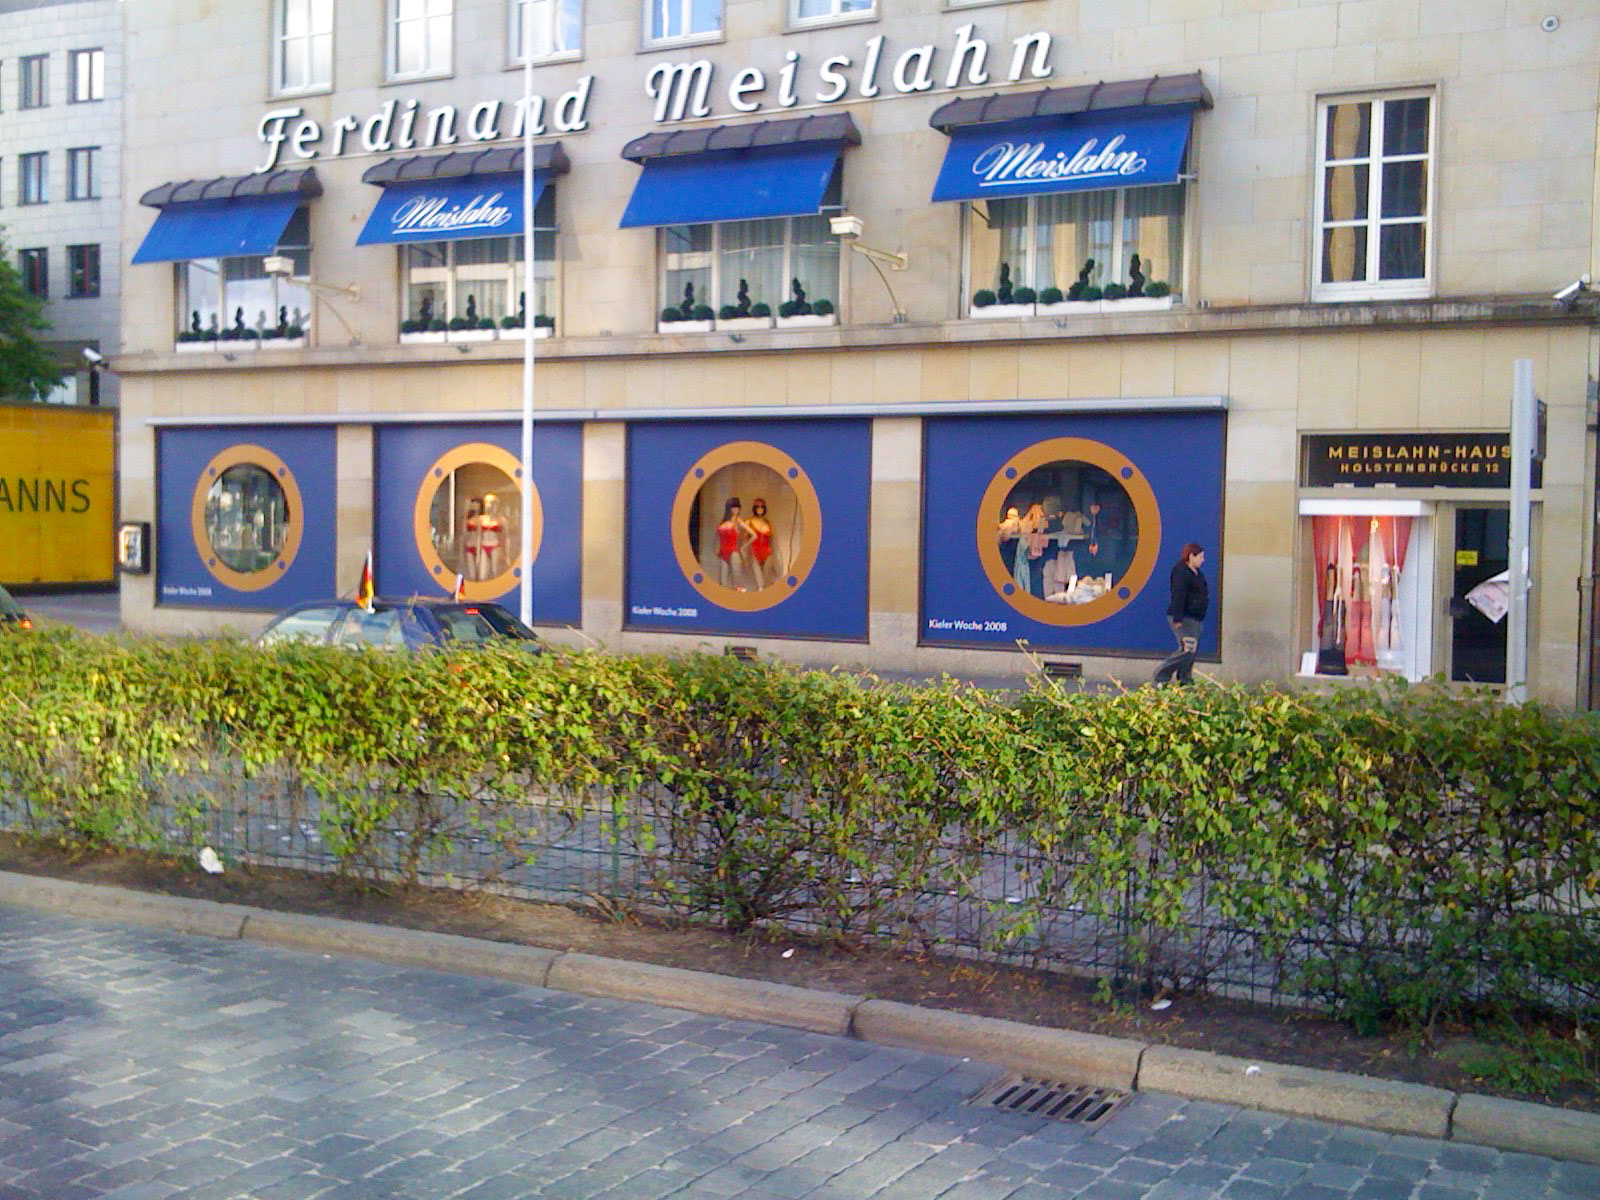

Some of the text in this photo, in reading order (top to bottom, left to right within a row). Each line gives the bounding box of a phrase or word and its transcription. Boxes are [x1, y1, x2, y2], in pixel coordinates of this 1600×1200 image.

[254, 23, 1053, 174] Ferdinand Meislahn
[972, 134, 1147, 177] Meislahn
[391, 191, 512, 229] Meislahn
[1328, 445, 1512, 459] MEISLAHN-HAUS
[1340, 461, 1500, 473] HOLSTENBRÜCKE 12
[928, 618, 1008, 632] Kieler Woche 2008
